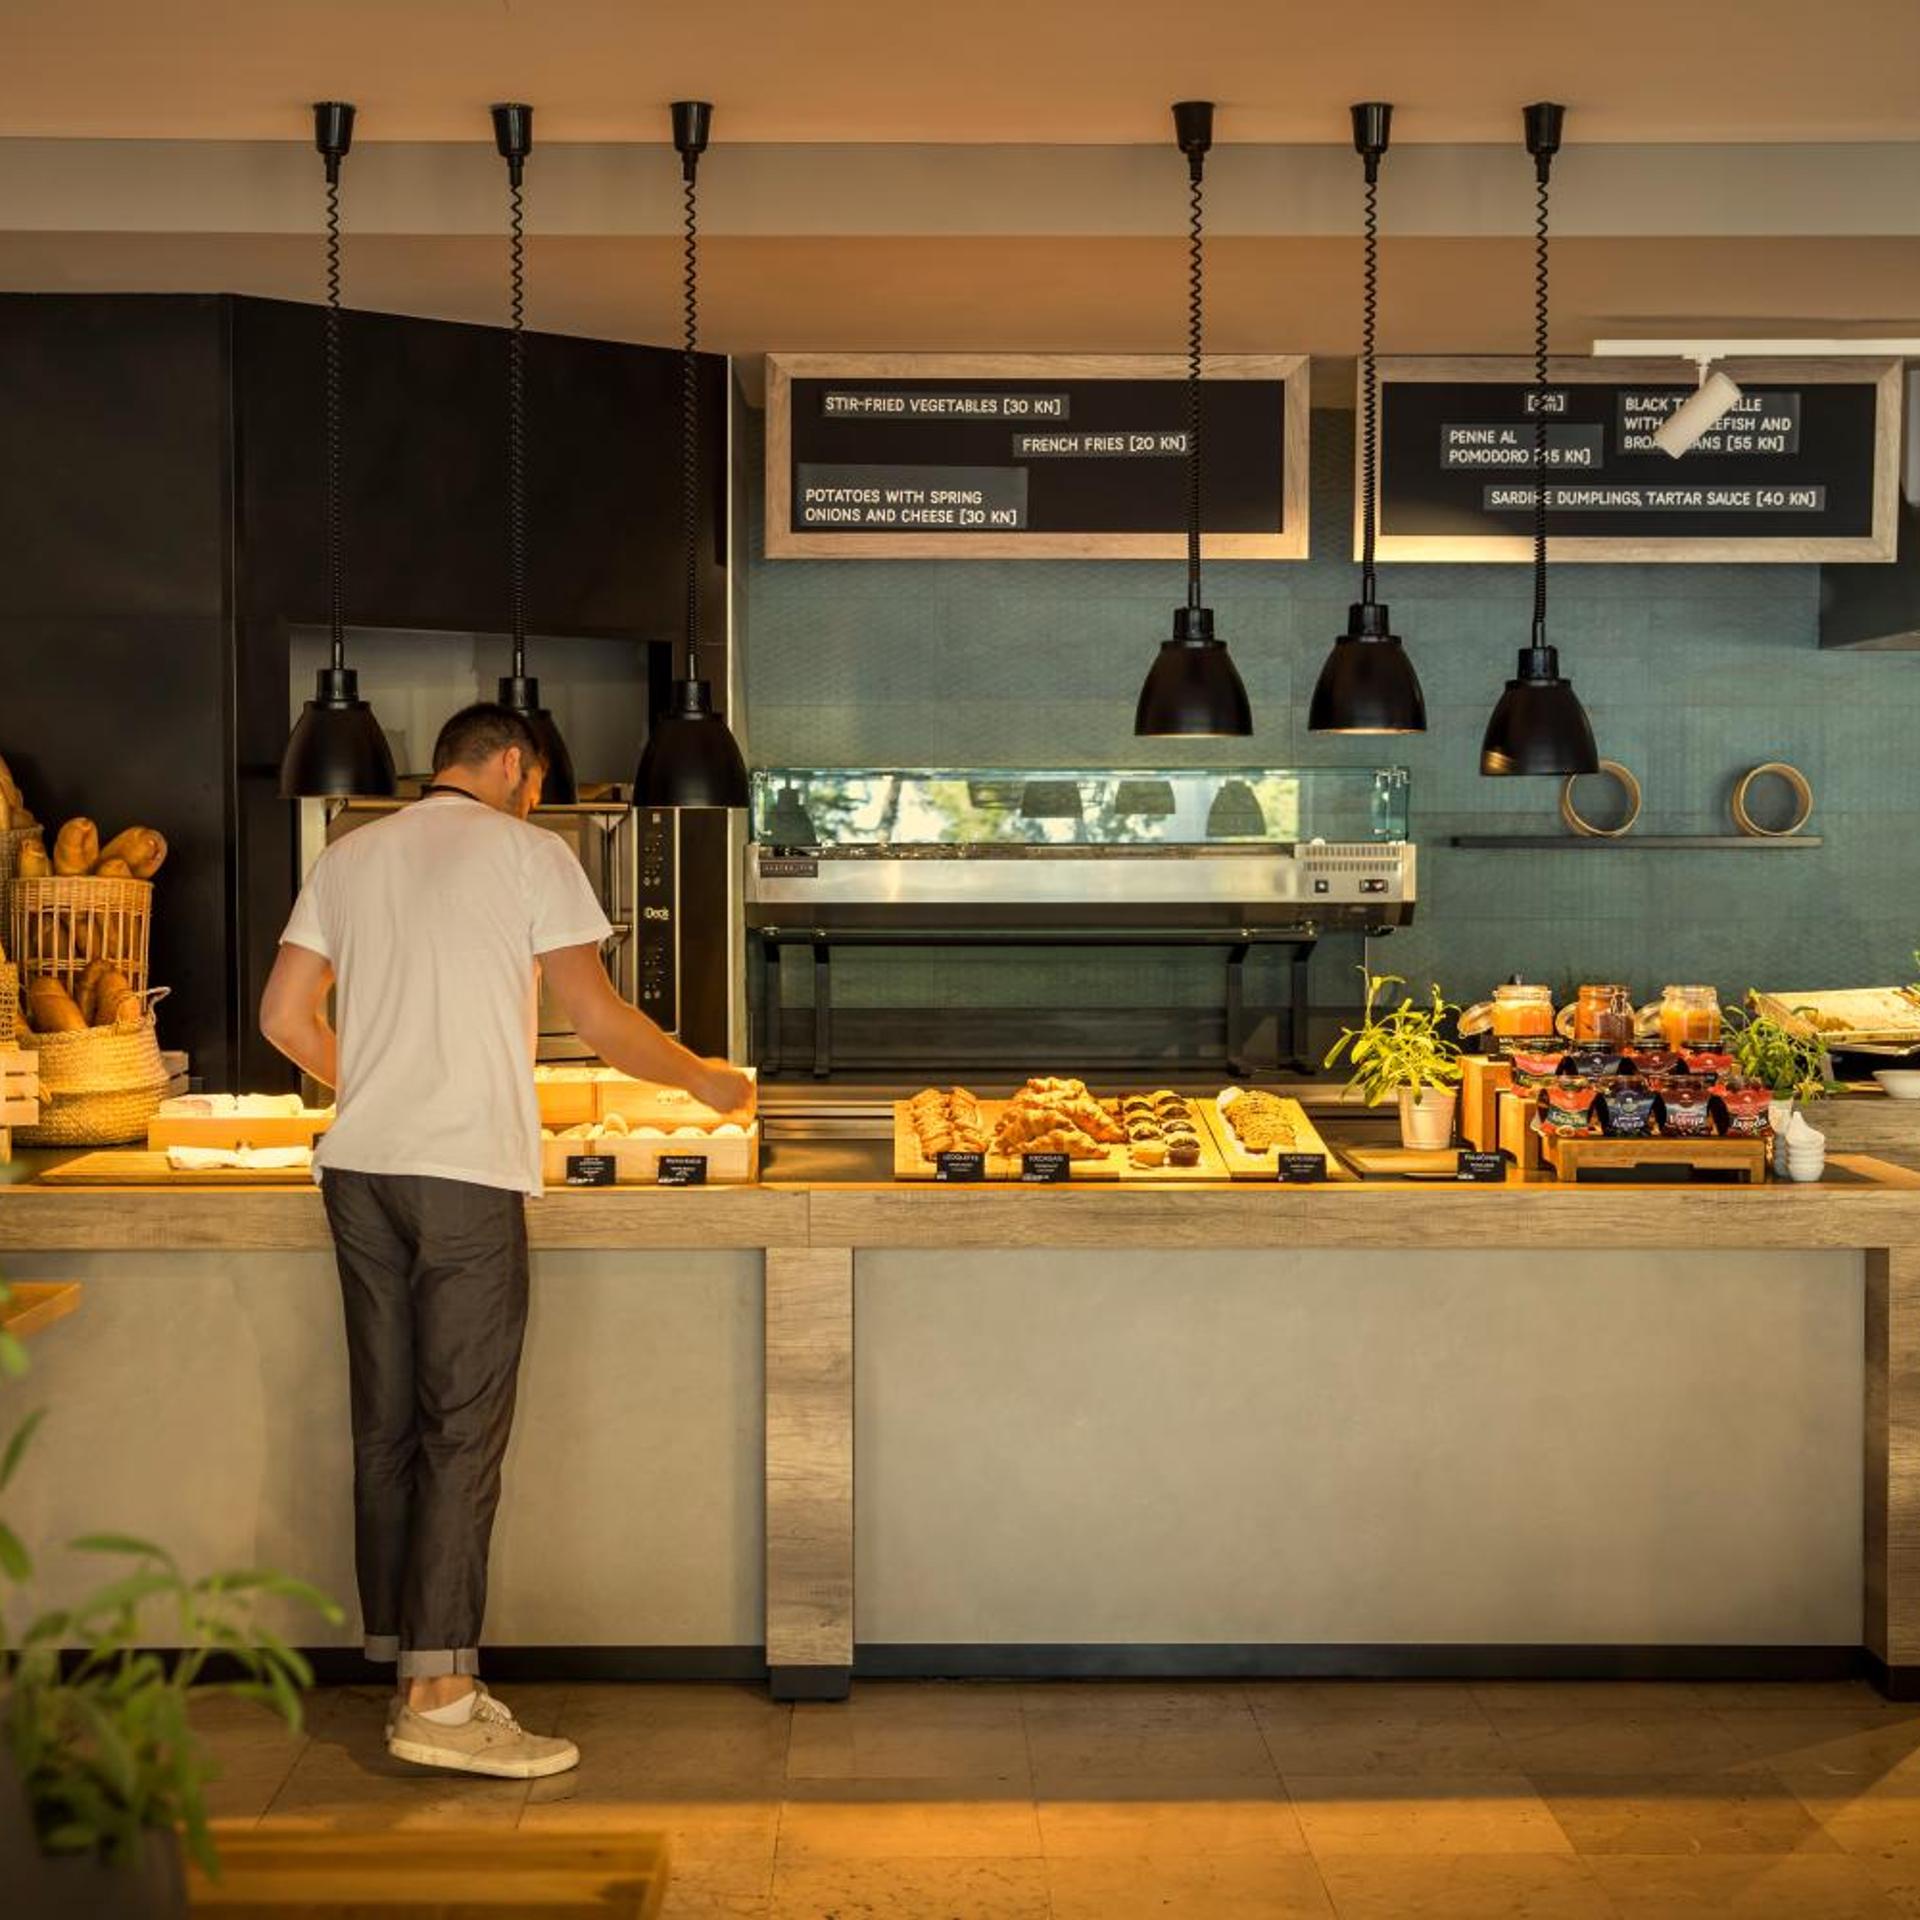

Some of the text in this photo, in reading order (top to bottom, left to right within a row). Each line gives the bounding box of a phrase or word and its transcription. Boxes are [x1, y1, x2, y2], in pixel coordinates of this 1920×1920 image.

[825, 396, 1061, 416] STIR-FRIED VEGETABLES [30 KN]
[1625, 397, 1668, 411] BLACK
[1623, 416, 1664, 431] WITH
[1760, 417, 1792, 431] AND
[1022, 434, 1187, 453] FRENCH FRIES [20 KN]
[1449, 429, 1518, 444] PENNE AL
[1726, 434, 1752, 452] [55
[1757, 435, 1784, 452] KN]
[1449, 448, 1530, 464] POMODORO
[1564, 447, 1591, 465] KN]
[805, 488, 982, 505] POTATOES WITH SPRING
[1557, 491, 1642, 508] DUMPLINGS,
[1646, 491, 1702, 506] TARTAR
[1706, 491, 1750, 506] SAUCE
[1756, 490, 1785, 508] [40
[1789, 490, 1817, 508] KN]
[805, 507, 1017, 526] ONIONS AND CHEESE [30 KN]
